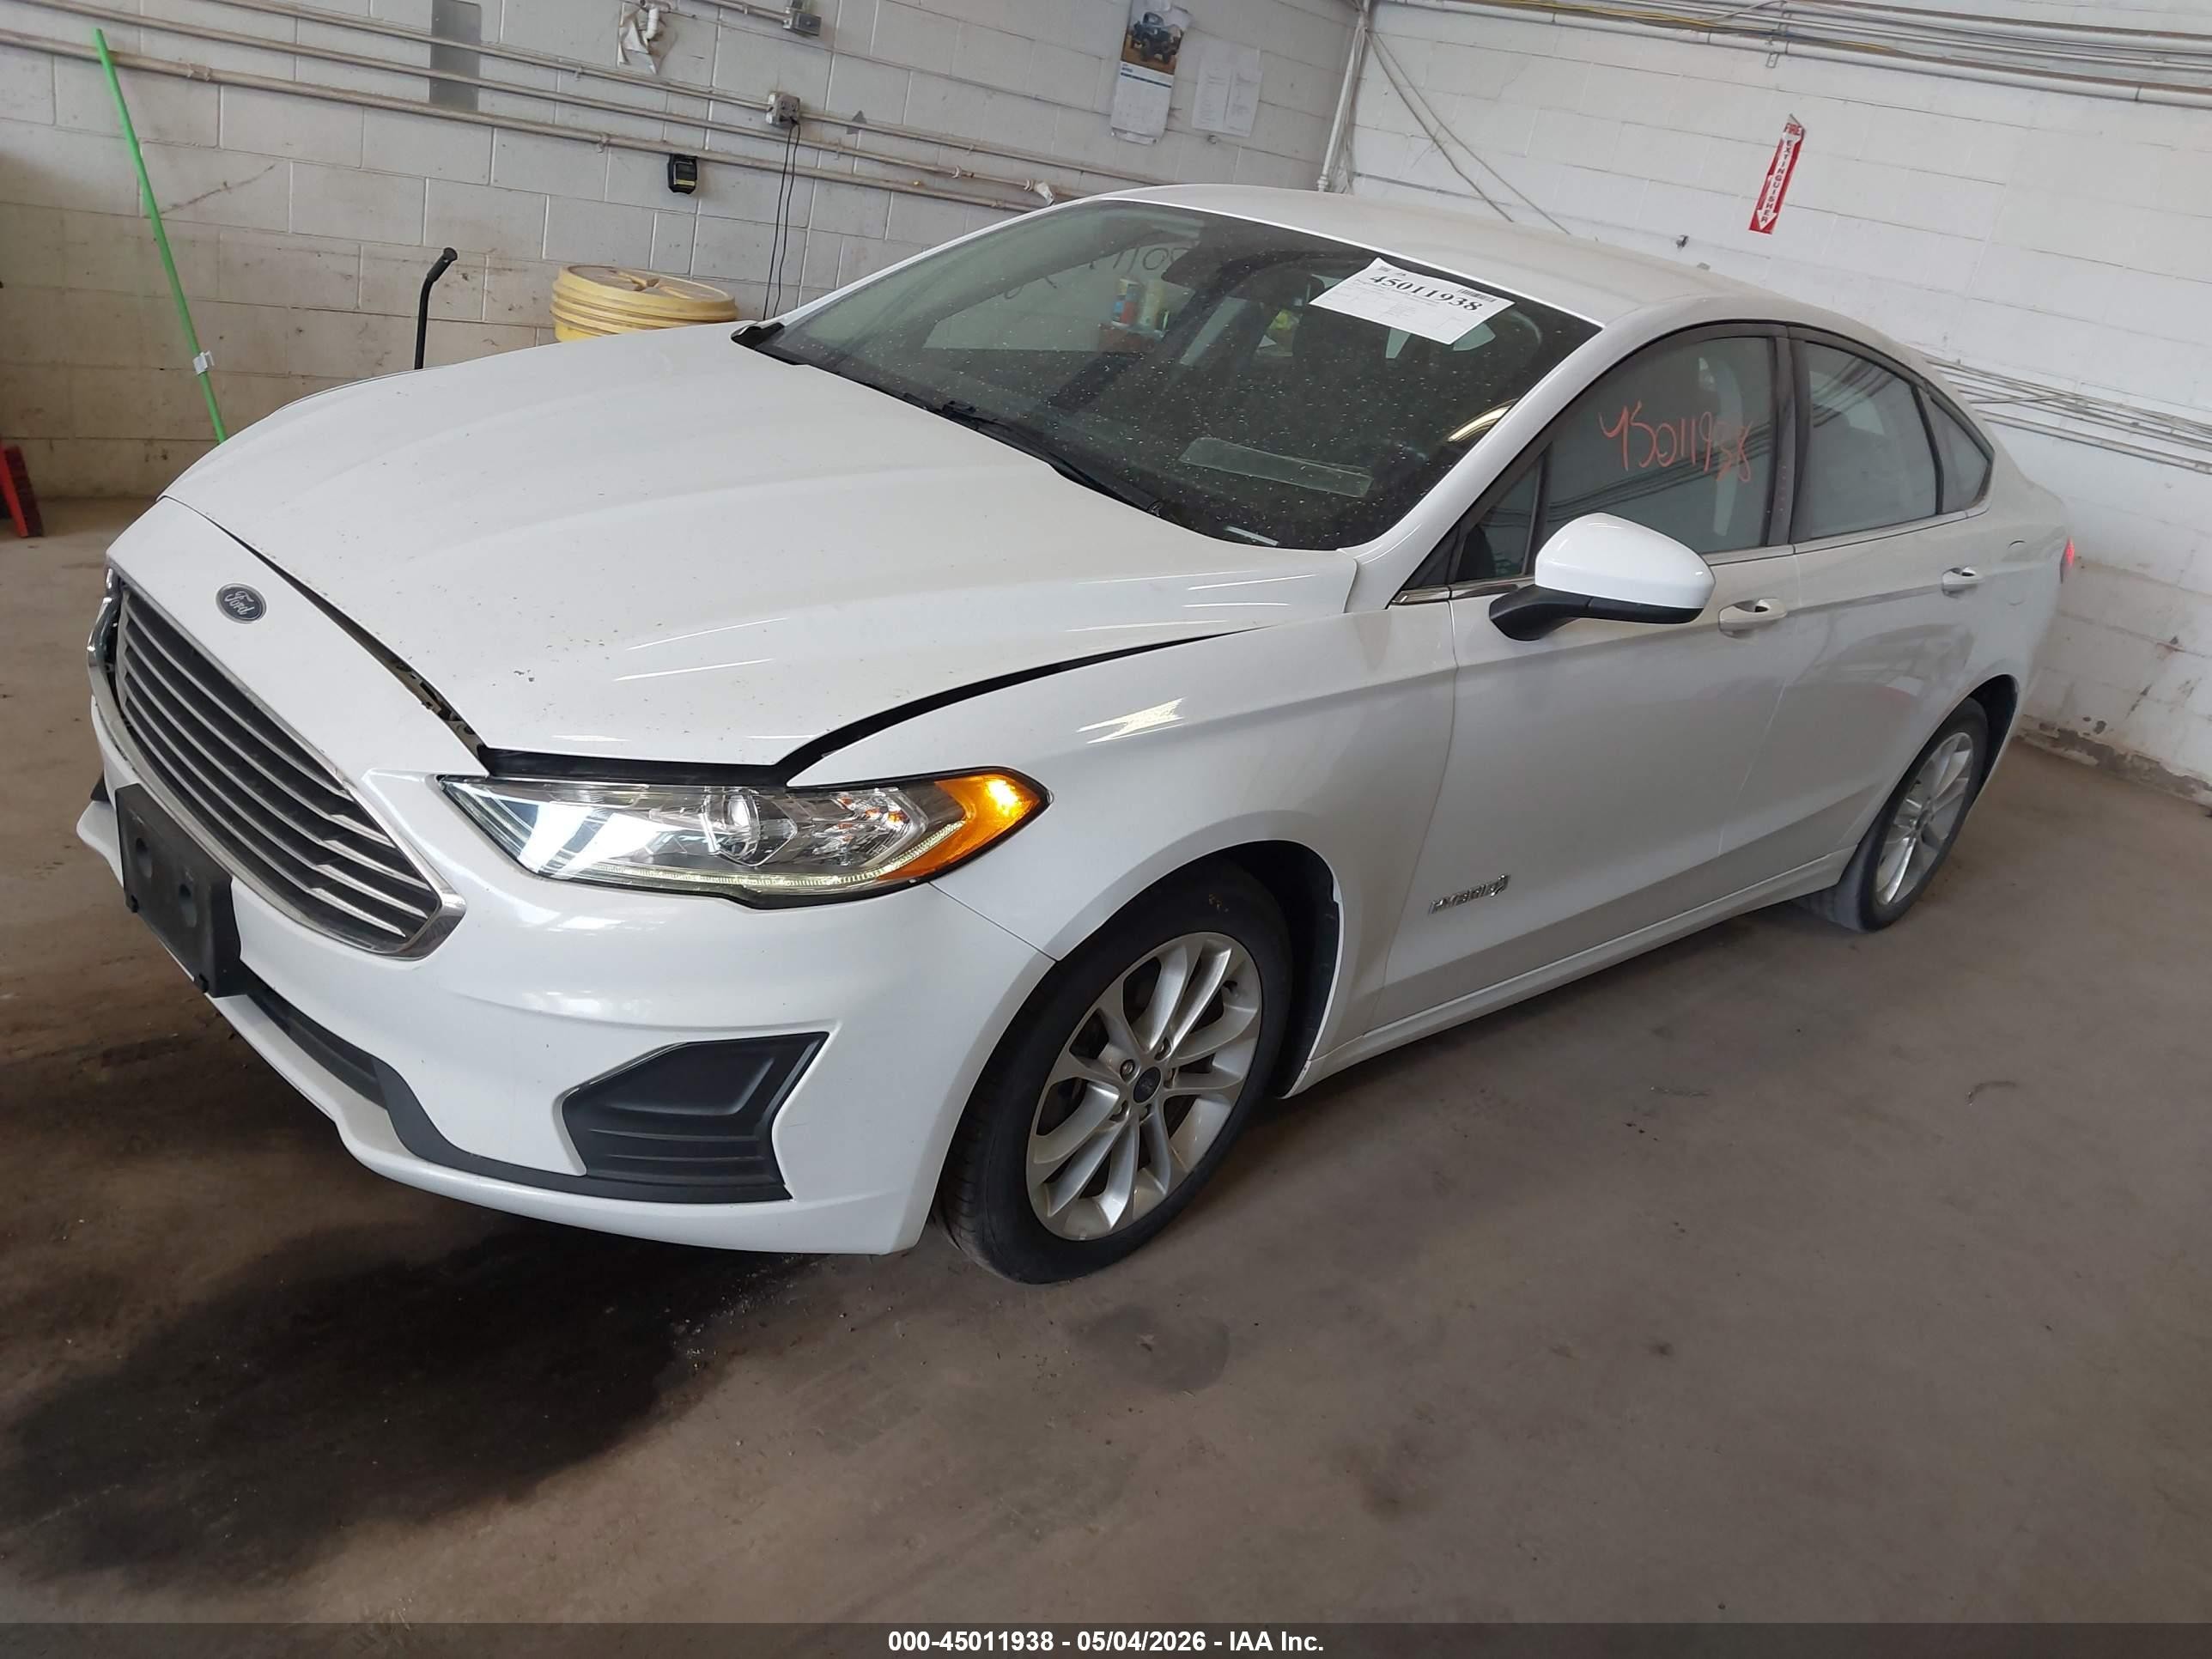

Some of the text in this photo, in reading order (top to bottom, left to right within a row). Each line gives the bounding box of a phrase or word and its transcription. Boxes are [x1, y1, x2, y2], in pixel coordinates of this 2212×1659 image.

[1760, 140, 1794, 223] EXTINGUISHER
[1370, 275, 1484, 311] 45011938
[224, 591, 255, 615] Ford
